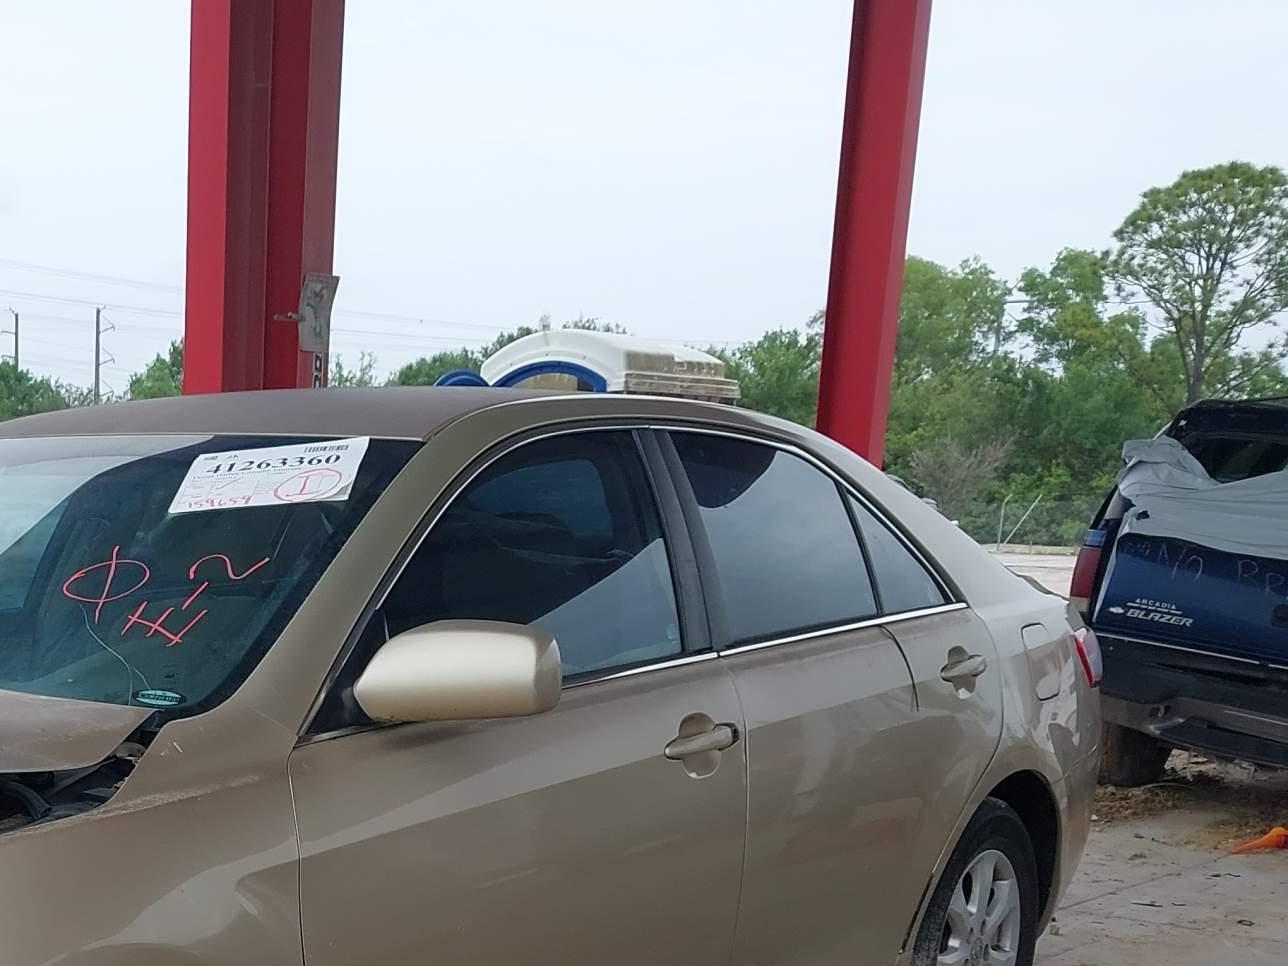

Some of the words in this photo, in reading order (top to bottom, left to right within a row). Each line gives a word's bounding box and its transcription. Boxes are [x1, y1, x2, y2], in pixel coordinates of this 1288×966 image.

[206, 454, 341, 475] 41263360
[1135, 598, 1177, 610] ARCADIA
[1126, 608, 1194, 627] BLAZER
